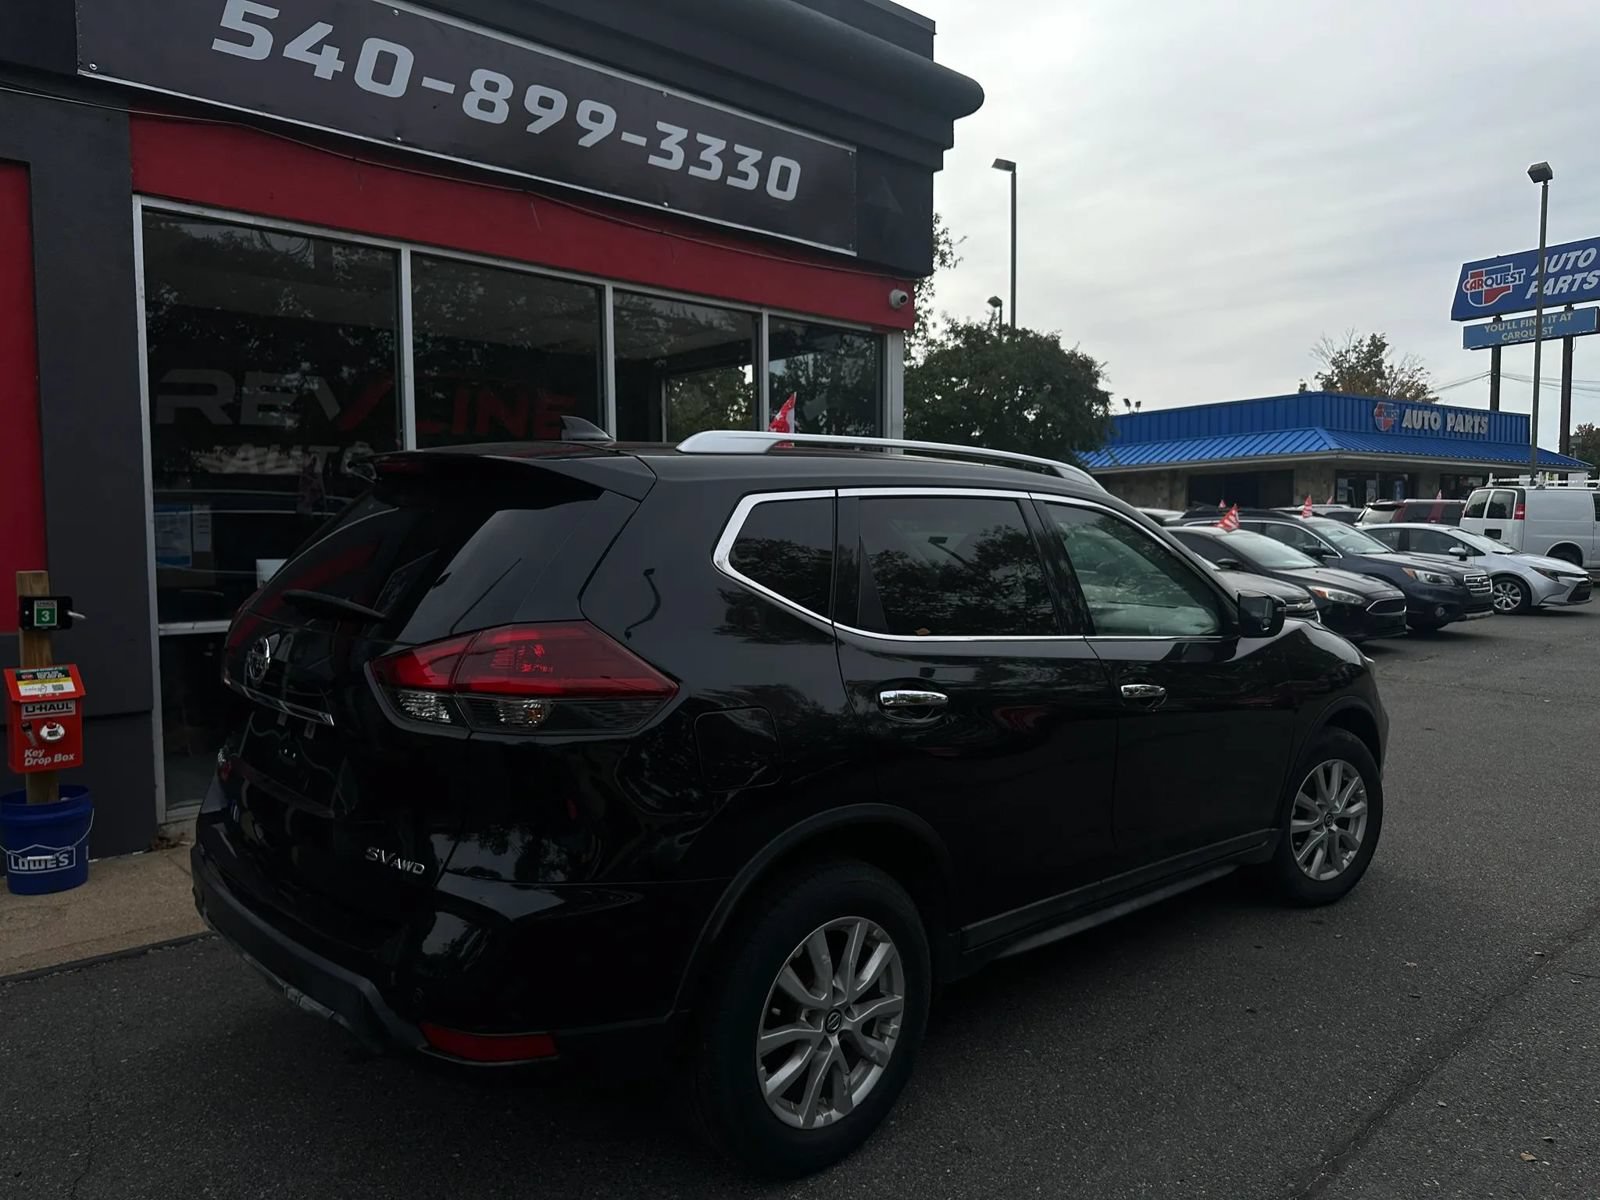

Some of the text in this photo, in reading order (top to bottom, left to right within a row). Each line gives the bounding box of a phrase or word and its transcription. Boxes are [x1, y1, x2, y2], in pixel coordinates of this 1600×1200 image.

[211, 0, 801, 201] 540-899-3330
[1463, 270, 1525, 291] CARQUEST
[1484, 312, 1573, 333] YOU'LL FIN IT AT
[1502, 326, 1553, 341] CARQUST
[1402, 408, 1442, 431] AUTO
[1446, 413, 1489, 434] PARTS
[41, 610, 51, 622] 3
[25, 702, 73, 713] U-HAUL
[24, 749, 45, 758] Key
[24, 753, 75, 767] Drop Box
[364, 846, 425, 875] SV AWD
